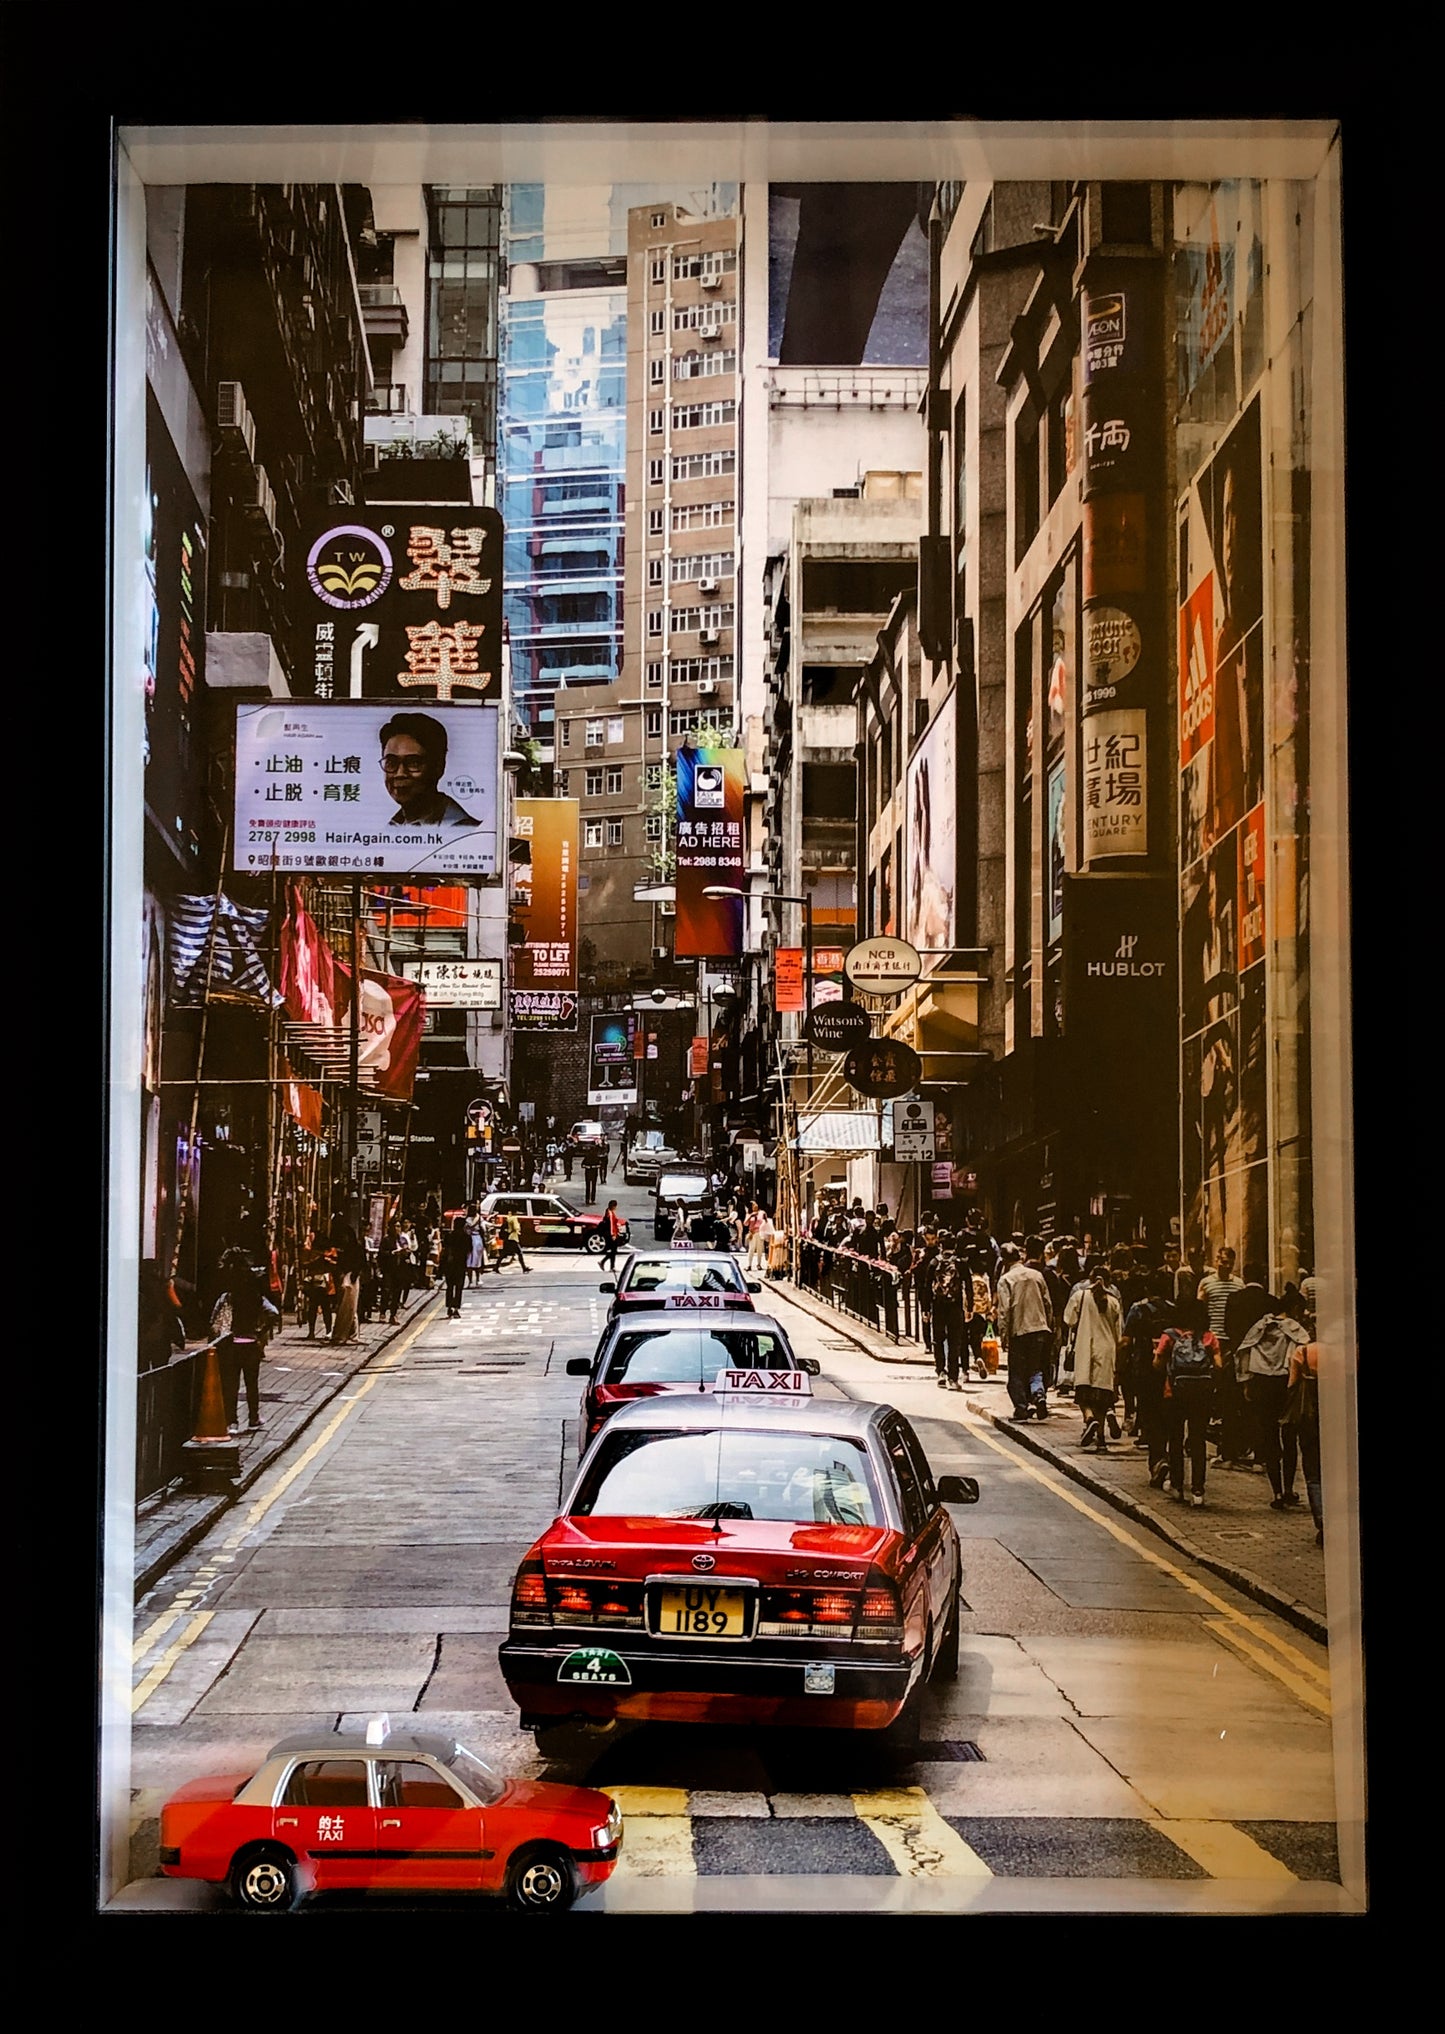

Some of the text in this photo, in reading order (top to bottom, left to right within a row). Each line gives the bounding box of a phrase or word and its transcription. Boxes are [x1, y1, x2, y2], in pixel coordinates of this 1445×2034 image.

[397, 526, 492, 699] 翠華
[1183, 684, 1212, 741] adidas
[265, 754, 361, 774] 止油 止痕
[679, 822, 740, 836] 廣告招租
[249, 831, 443, 846] 2787 2998 HairAgain.com.hk
[678, 836, 740, 848] AD HERE
[533, 949, 570, 961] TO LET
[868, 950, 895, 960] NCB
[1087, 962, 1165, 976] HUBLOT
[813, 1015, 864, 1026] Watson's
[813, 1027, 843, 1039] Wine
[920, 1135, 927, 1144] 7
[367, 1146, 373, 1154] 7
[921, 1150, 933, 1159] 12
[366, 1161, 378, 1169] 12
[671, 1296, 720, 1307] TAXI
[726, 1371, 801, 1390] TAXI
[685, 1586, 720, 1611] UY
[676, 1610, 728, 1633] 1189
[587, 1658, 601, 1672] 4
[572, 1672, 616, 1681] SEATS
[319, 1815, 344, 1830] 的士
[317, 1830, 343, 1841] TAXI
